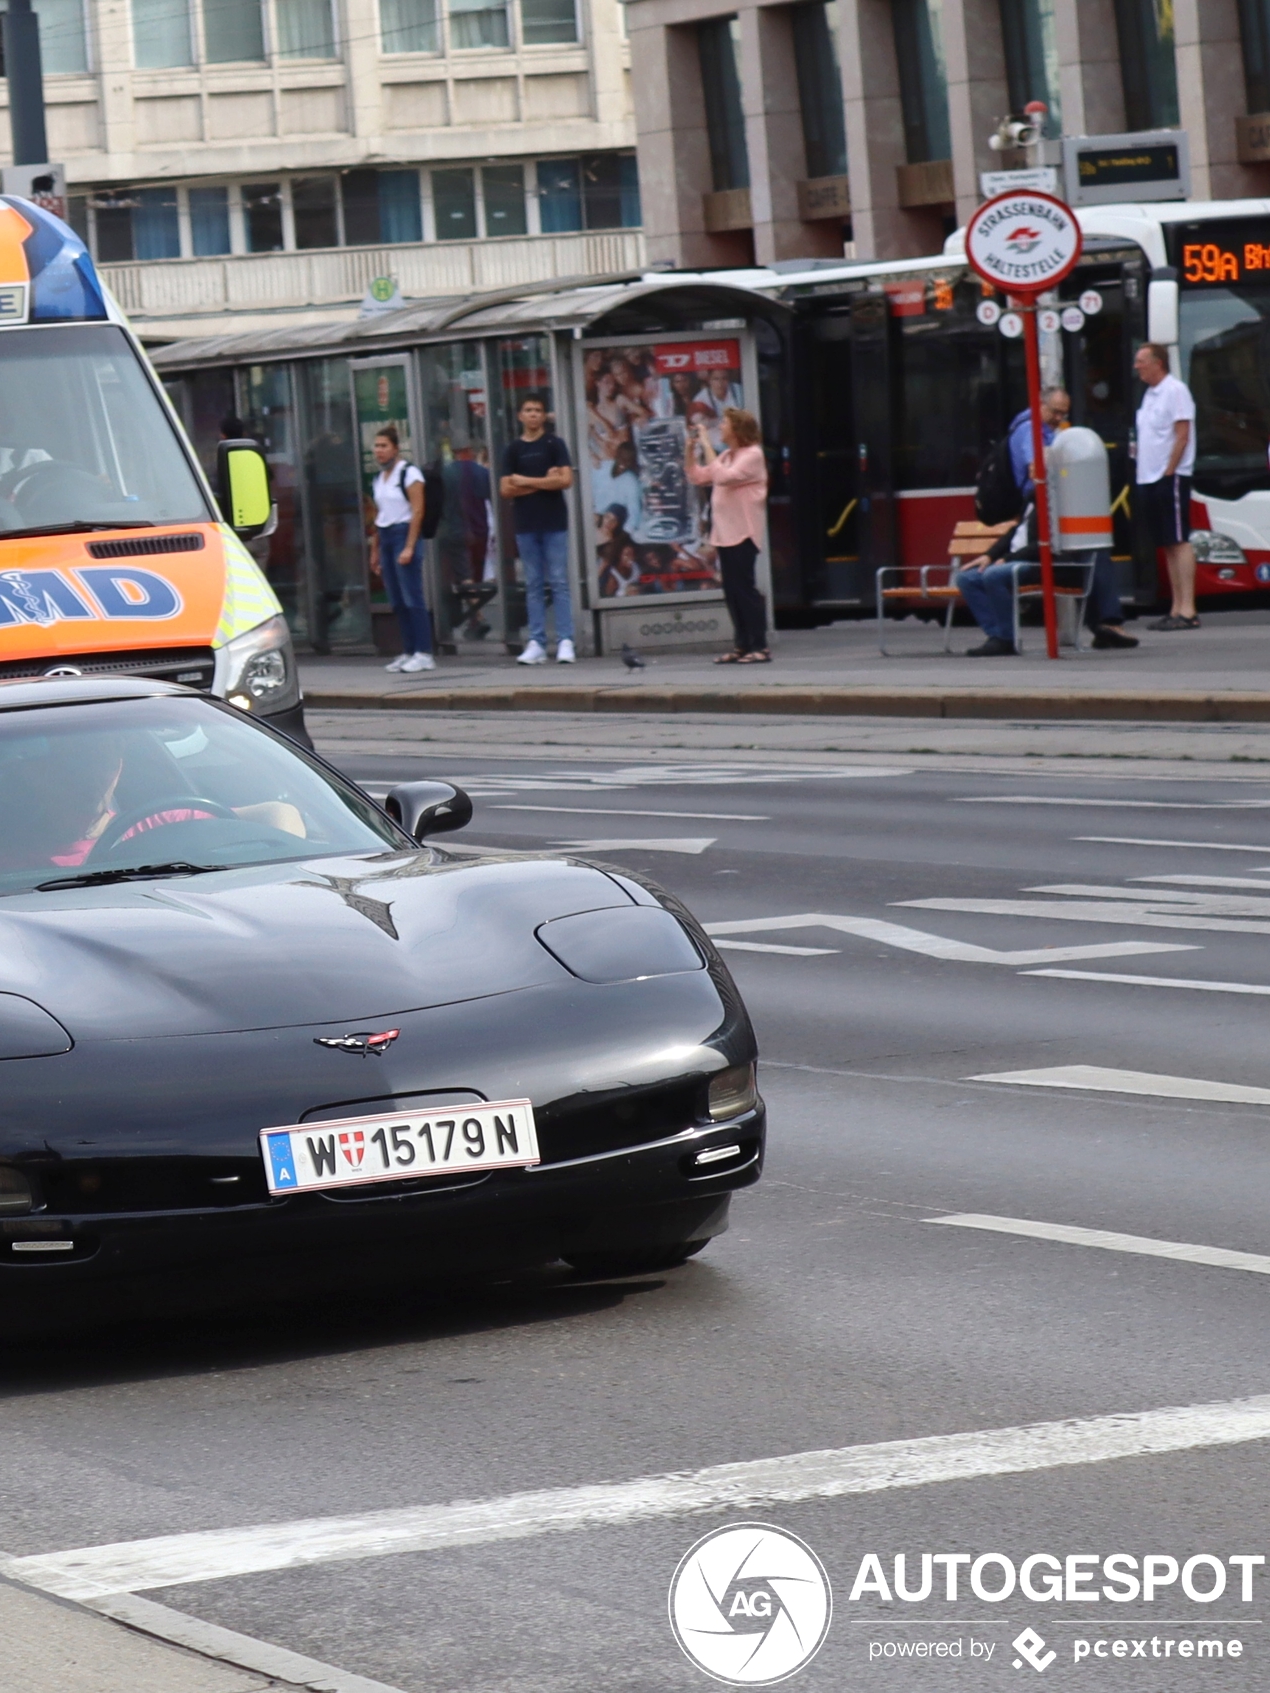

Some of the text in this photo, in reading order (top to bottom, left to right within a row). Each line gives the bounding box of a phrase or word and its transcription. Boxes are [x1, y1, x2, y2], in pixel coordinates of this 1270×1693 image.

[978, 202, 1067, 237] STRASSENBAHN
[984, 248, 1065, 278] HALTESTELLE
[279, 1113, 519, 1181] A W 15179 N
